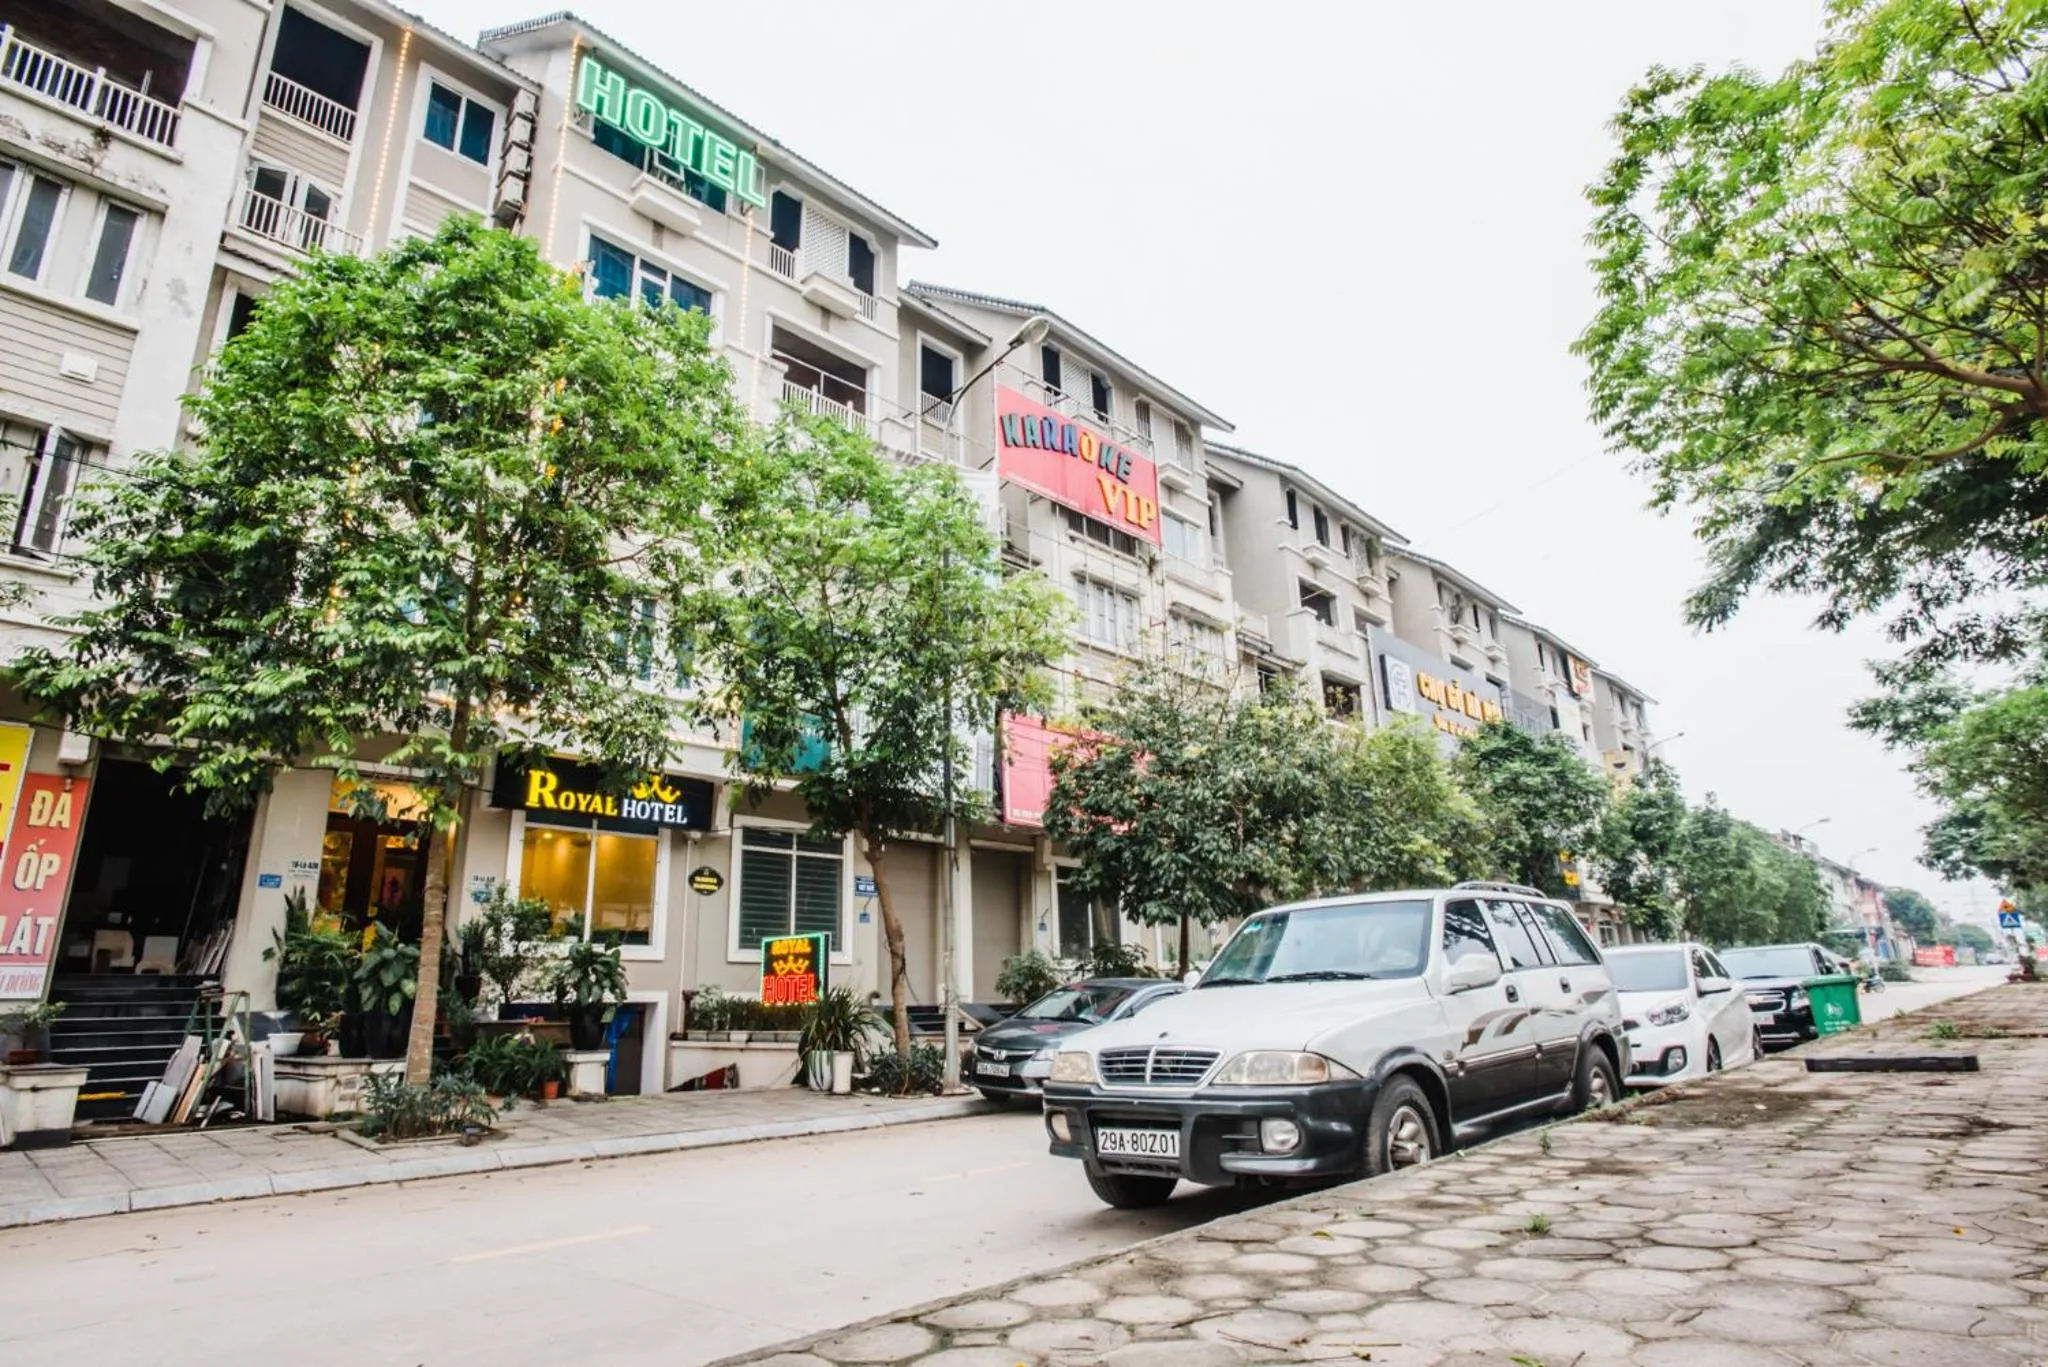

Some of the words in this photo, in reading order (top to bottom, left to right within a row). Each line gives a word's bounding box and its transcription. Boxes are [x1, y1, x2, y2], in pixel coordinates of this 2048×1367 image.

[577, 56, 765, 208] HOTEL
[1001, 412, 1133, 484] KARAOKE
[1097, 475, 1157, 530] VIP
[621, 798, 688, 825] HOTEL
[14, 839, 61, 890] ỐP
[0, 908, 54, 955] LÁT
[771, 938, 811, 955] ROYAL
[763, 973, 819, 1003] HOTEL
